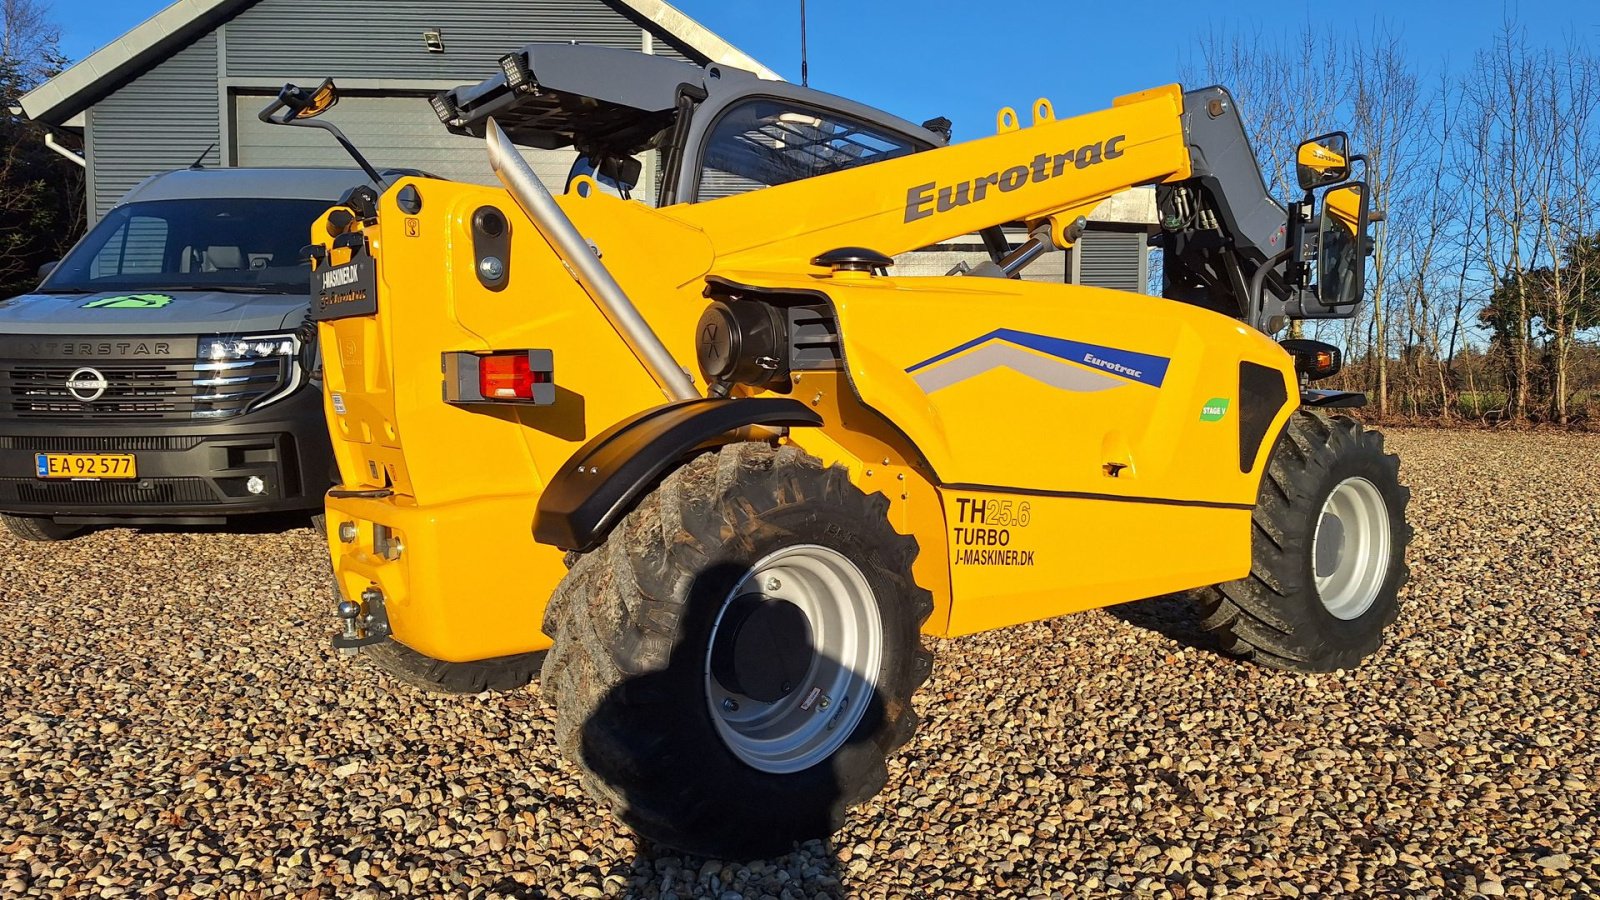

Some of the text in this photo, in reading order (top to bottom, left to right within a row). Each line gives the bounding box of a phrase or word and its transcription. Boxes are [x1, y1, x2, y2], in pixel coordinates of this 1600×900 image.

[904, 135, 1126, 224] Eurotrac
[1084, 353, 1142, 378] Eurotrac
[65, 380, 108, 389] NISSAN
[1203, 407, 1226, 415] STAGE V
[49, 457, 131, 474] EA 92 577
[956, 498, 1031, 527] TH25.6
[954, 528, 1010, 546] TURBO
[955, 549, 1035, 566] J-MASKINER.DK
